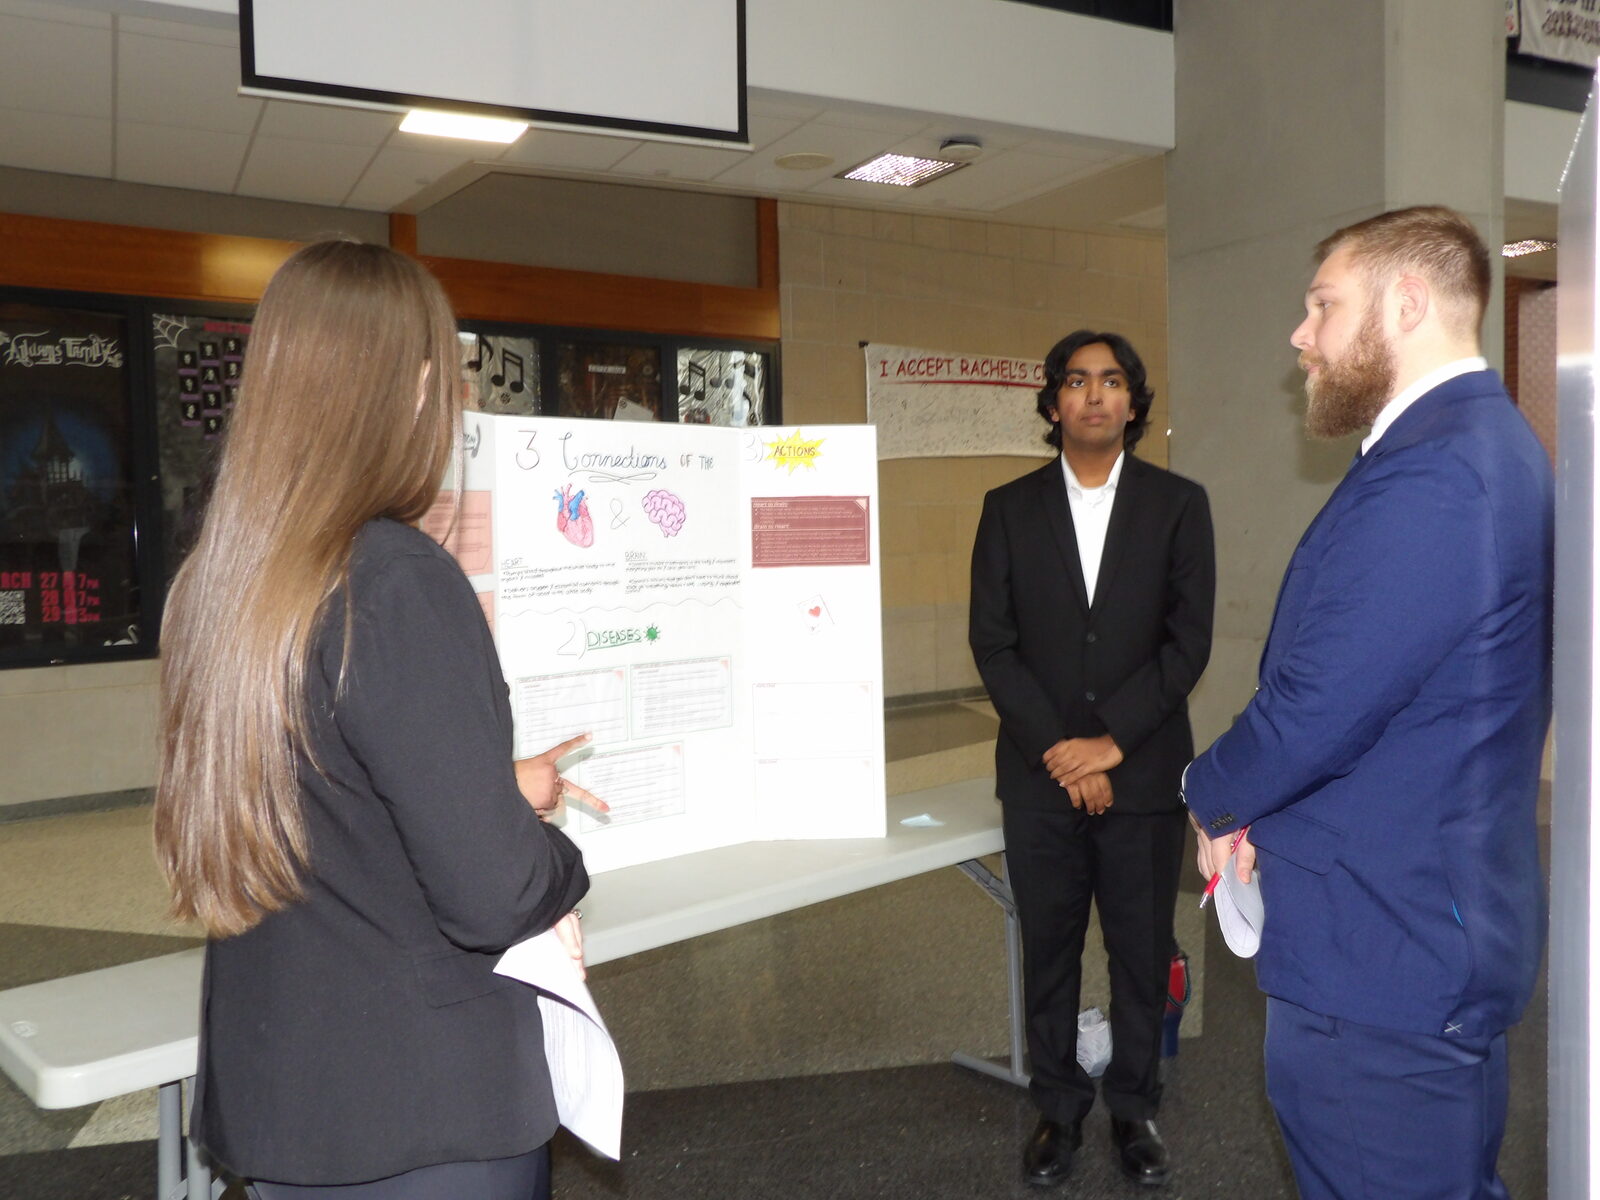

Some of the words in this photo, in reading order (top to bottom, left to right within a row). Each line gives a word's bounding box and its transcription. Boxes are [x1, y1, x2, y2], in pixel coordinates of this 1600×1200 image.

[4, 331, 62, 367] Addams
[59, 334, 117, 367] Family
[880, 360, 888, 377] I
[896, 357, 954, 377] ACCEPT
[960, 359, 1028, 380] RACHEL'S
[515, 430, 540, 470] 3
[559, 431, 667, 471] Connections
[680, 453, 693, 468] OF
[699, 455, 714, 470] THE
[773, 445, 817, 458] ACTIONS
[609, 497, 631, 530] &
[40, 572, 58, 588] 27
[556, 618, 587, 660] 2)
[587, 628, 642, 647] DISEASES
